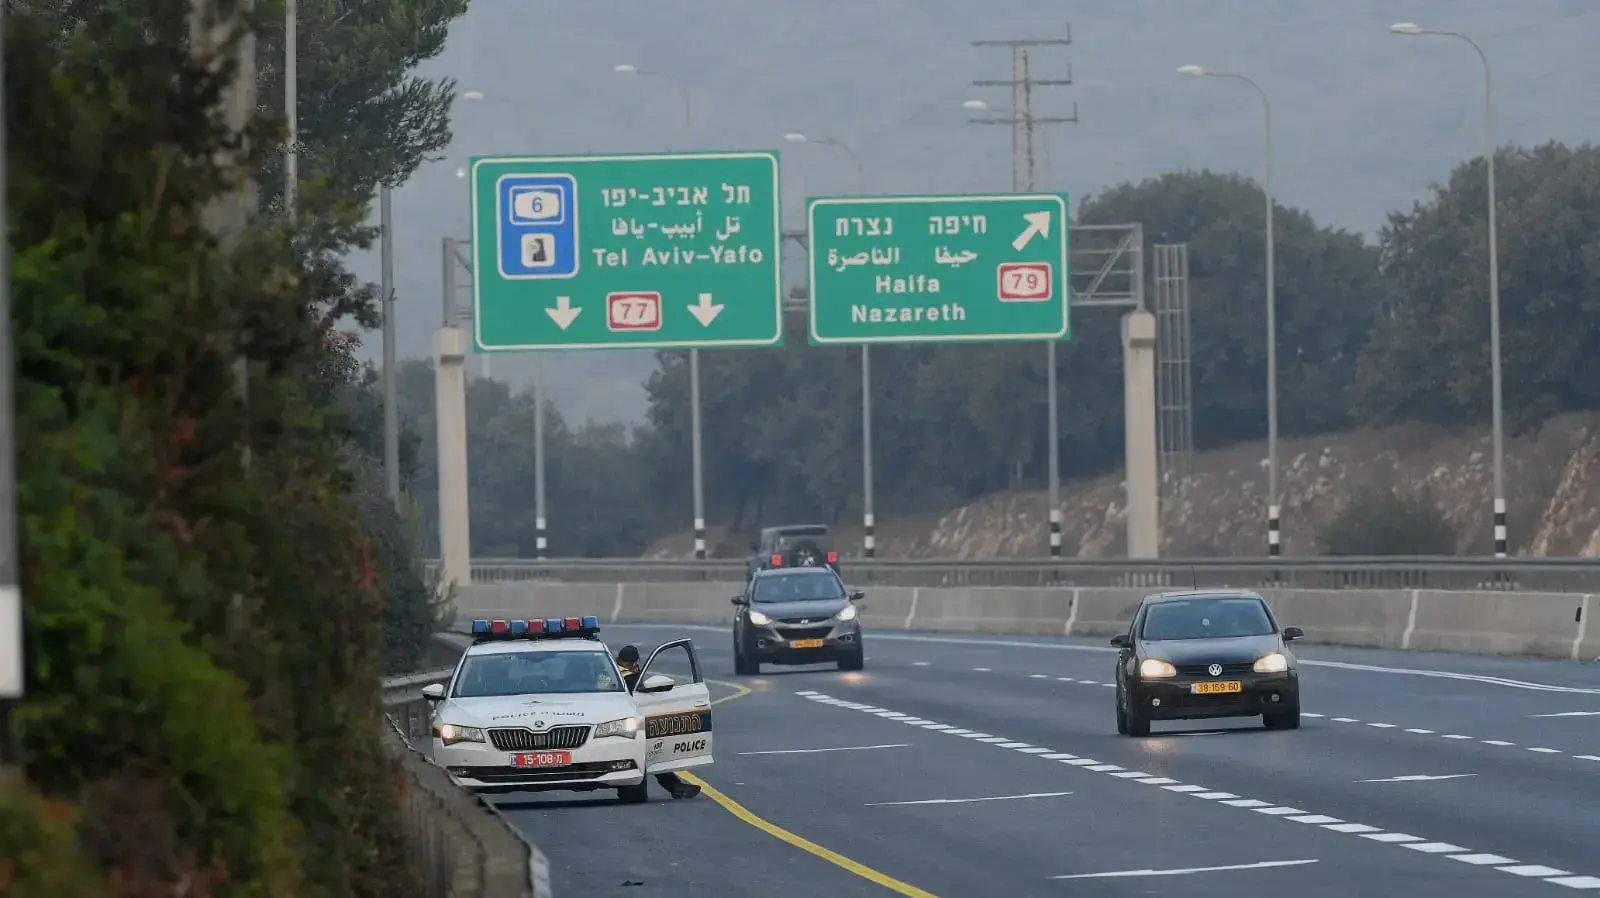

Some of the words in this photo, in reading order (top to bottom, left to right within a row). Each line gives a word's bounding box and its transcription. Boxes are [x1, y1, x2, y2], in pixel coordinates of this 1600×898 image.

[601, 185, 708, 207] אביב-יפו
[722, 183, 750, 204] תל
[532, 196, 543, 213] 6
[611, 210, 703, 239] أبيب-يافا
[716, 216, 741, 241] تل
[836, 217, 893, 236] נצרת
[929, 215, 987, 235] חיפה
[592, 248, 628, 267] Tel
[828, 247, 900, 272] الناصرة
[934, 246, 978, 267] حيفا
[875, 274, 940, 293] Haifa
[1012, 273, 1039, 290] 79
[621, 303, 649, 319] 77
[852, 303, 966, 323] Nazareth
[649, 713, 701, 736] התנועה
[673, 739, 706, 753] POLICE
